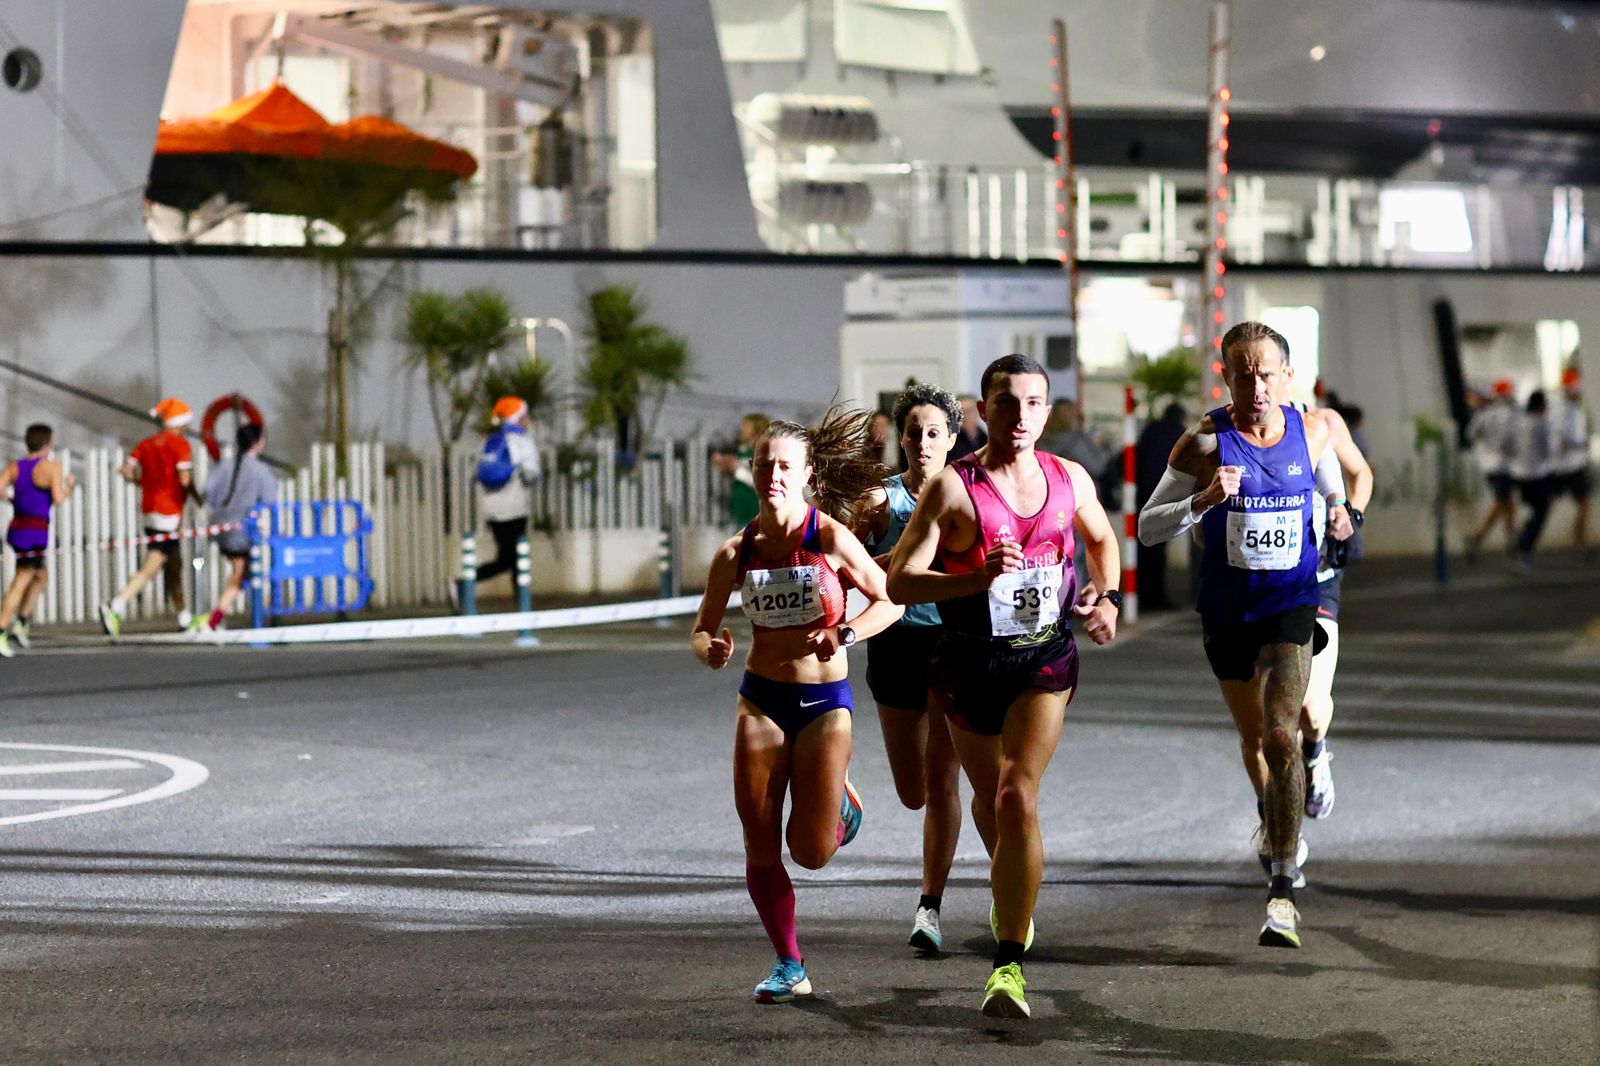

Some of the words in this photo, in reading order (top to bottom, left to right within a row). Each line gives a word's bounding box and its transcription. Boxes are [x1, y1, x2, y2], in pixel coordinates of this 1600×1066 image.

[1230, 495, 1306, 508] TROTASIERRA
[1276, 515, 1286, 525] M
[1245, 529, 1286, 548] 548
[788, 570, 799, 580] M
[750, 592, 801, 611] 1202
